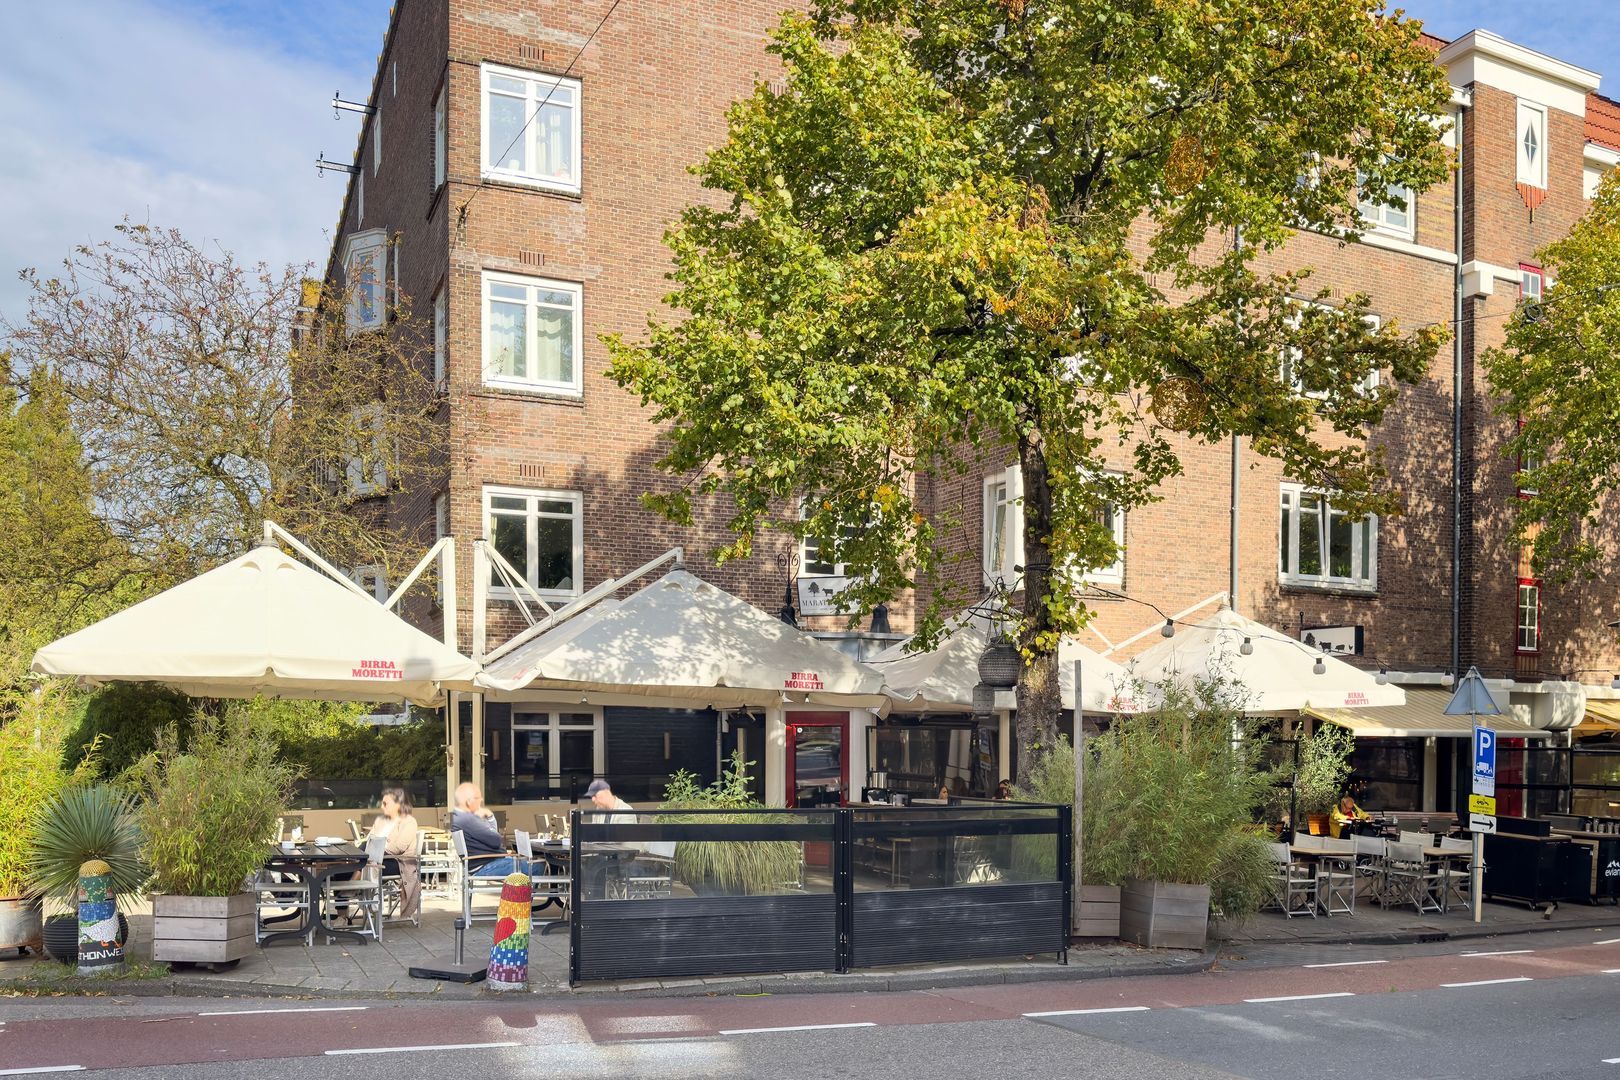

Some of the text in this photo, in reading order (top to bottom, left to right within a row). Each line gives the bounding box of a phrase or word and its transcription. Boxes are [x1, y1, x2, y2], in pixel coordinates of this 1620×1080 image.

[361, 660, 395, 669] BIRRA
[352, 669, 403, 679] MORETTI
[791, 672, 818, 681] BIRRA
[784, 680, 824, 690] MORETTI
[1479, 731, 1491, 756] P
